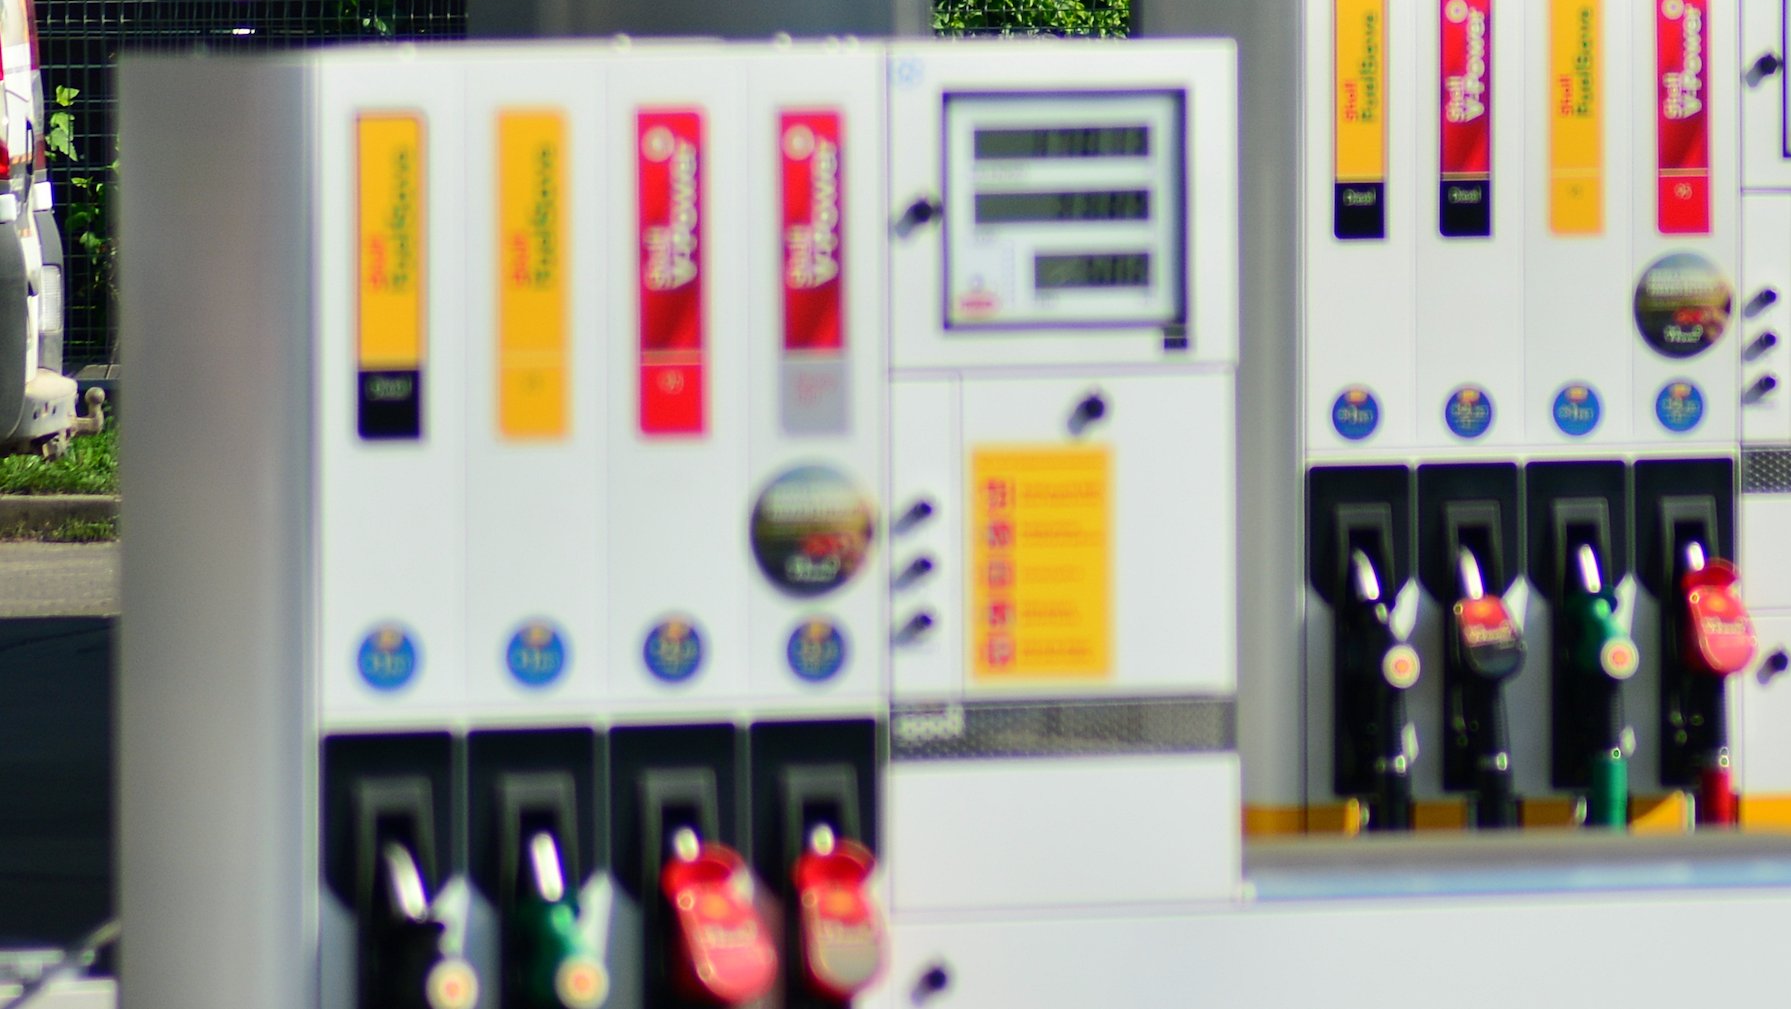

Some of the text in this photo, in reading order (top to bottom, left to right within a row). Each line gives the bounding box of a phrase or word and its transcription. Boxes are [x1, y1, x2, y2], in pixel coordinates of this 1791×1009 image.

[1444, 75, 1464, 123] Shell
[1464, 5, 1486, 122] V-Power
[1662, 71, 1682, 120] Shell
[1681, 2, 1702, 119] V-Power
